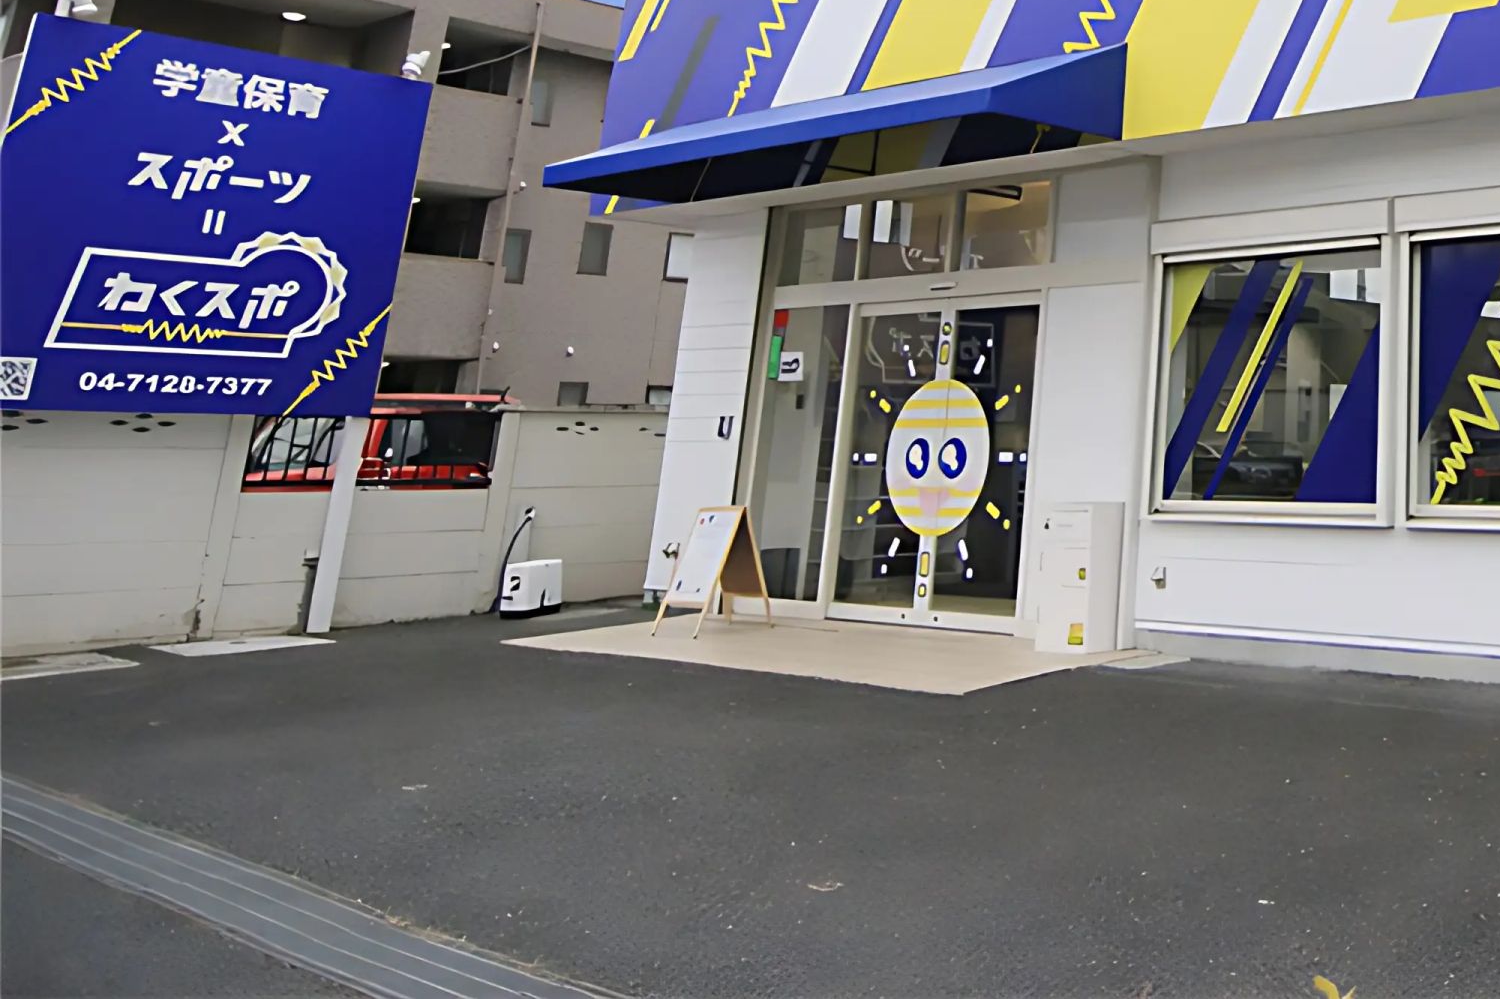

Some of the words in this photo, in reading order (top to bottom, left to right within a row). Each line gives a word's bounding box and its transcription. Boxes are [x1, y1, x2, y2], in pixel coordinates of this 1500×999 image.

[153, 59, 329, 119] 学童保育
[127, 152, 312, 204] スポーツ
[98, 272, 300, 329] わくスポ
